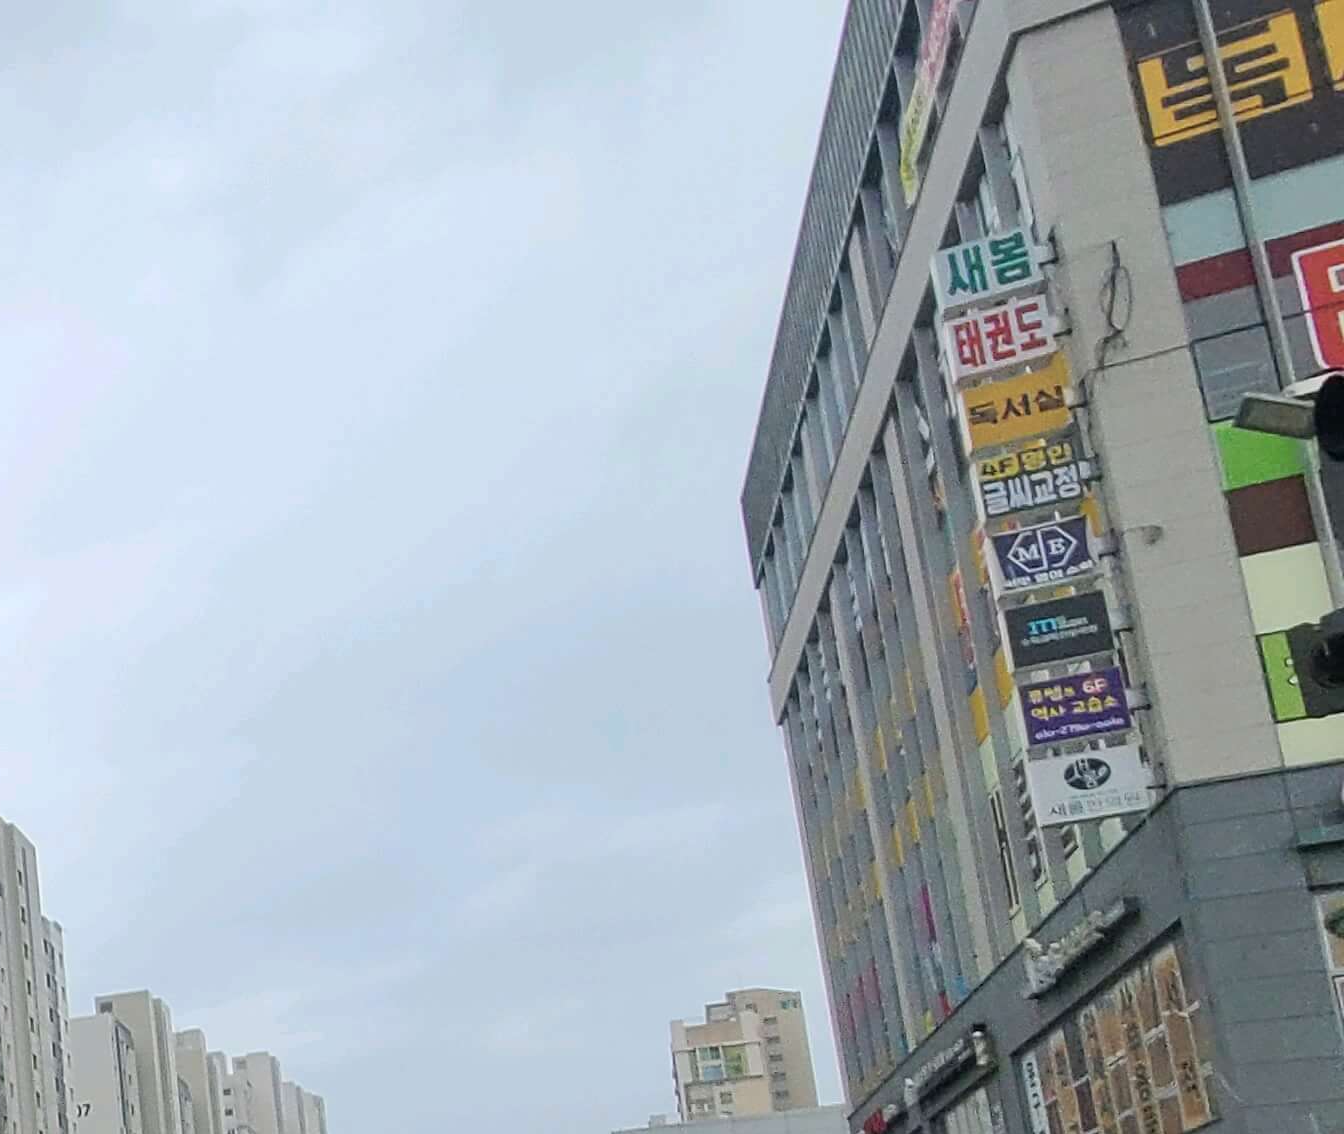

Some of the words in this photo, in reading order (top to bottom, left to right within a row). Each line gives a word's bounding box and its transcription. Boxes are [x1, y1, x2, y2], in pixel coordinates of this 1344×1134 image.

[947, 231, 1033, 296] 새봄
[954, 301, 1049, 369] 태권도
[968, 384, 1066, 427] 독서실
